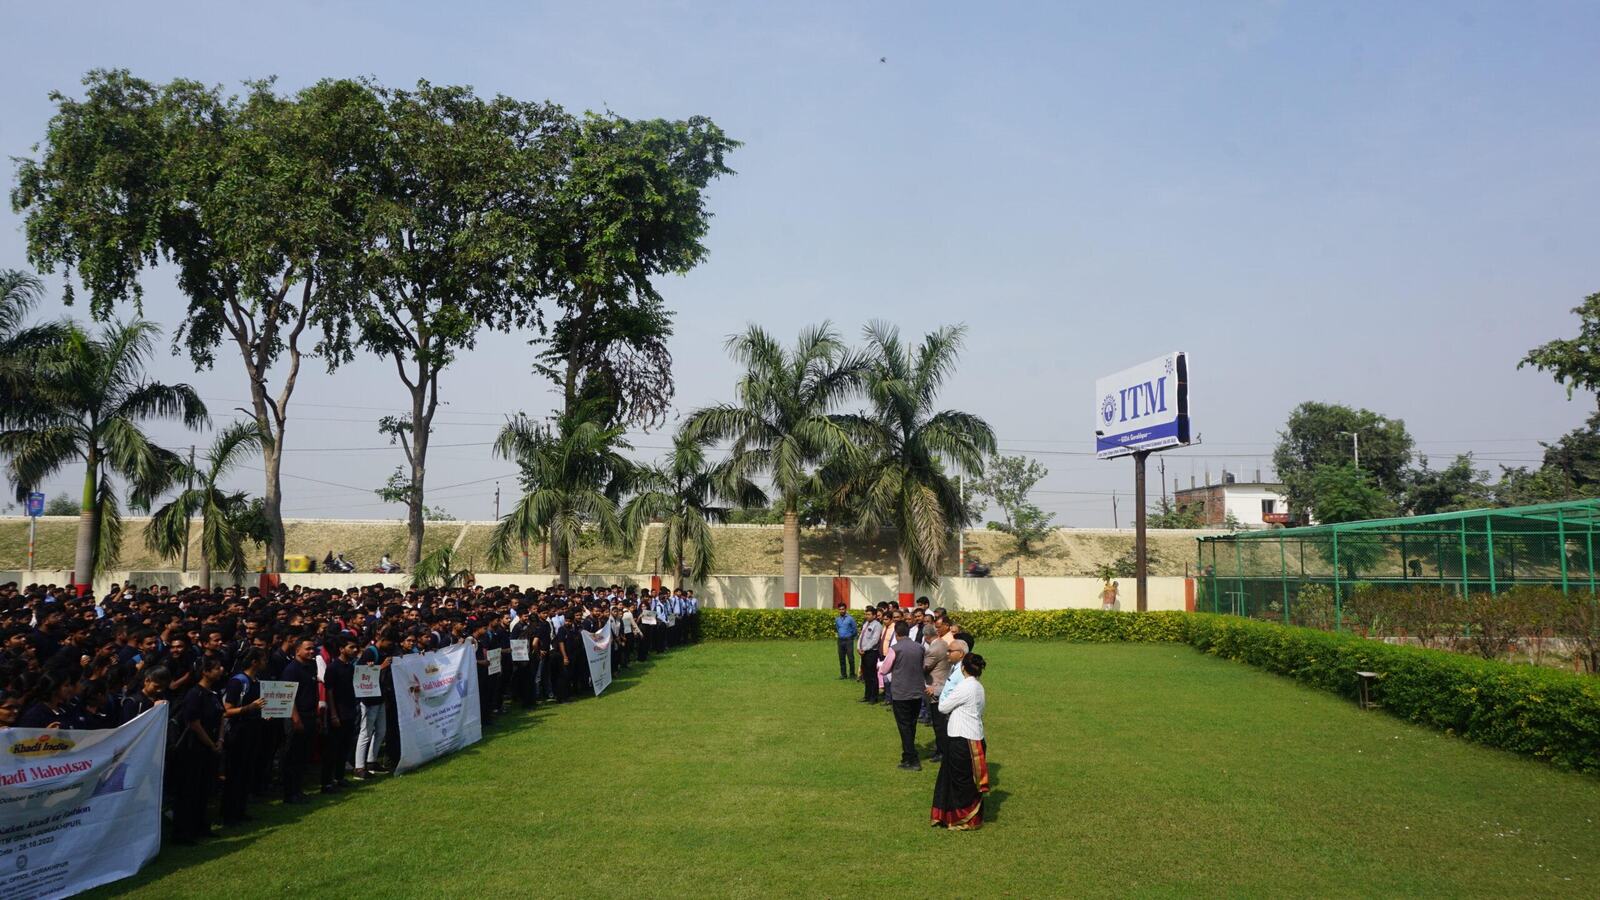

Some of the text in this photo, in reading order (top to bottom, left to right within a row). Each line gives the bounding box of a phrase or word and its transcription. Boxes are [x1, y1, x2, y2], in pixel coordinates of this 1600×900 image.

[1119, 376, 1167, 422] ITM
[361, 673, 371, 682] Buy
[14, 742, 70, 754] Khadi India
[29, 759, 93, 780] Mahotsav
